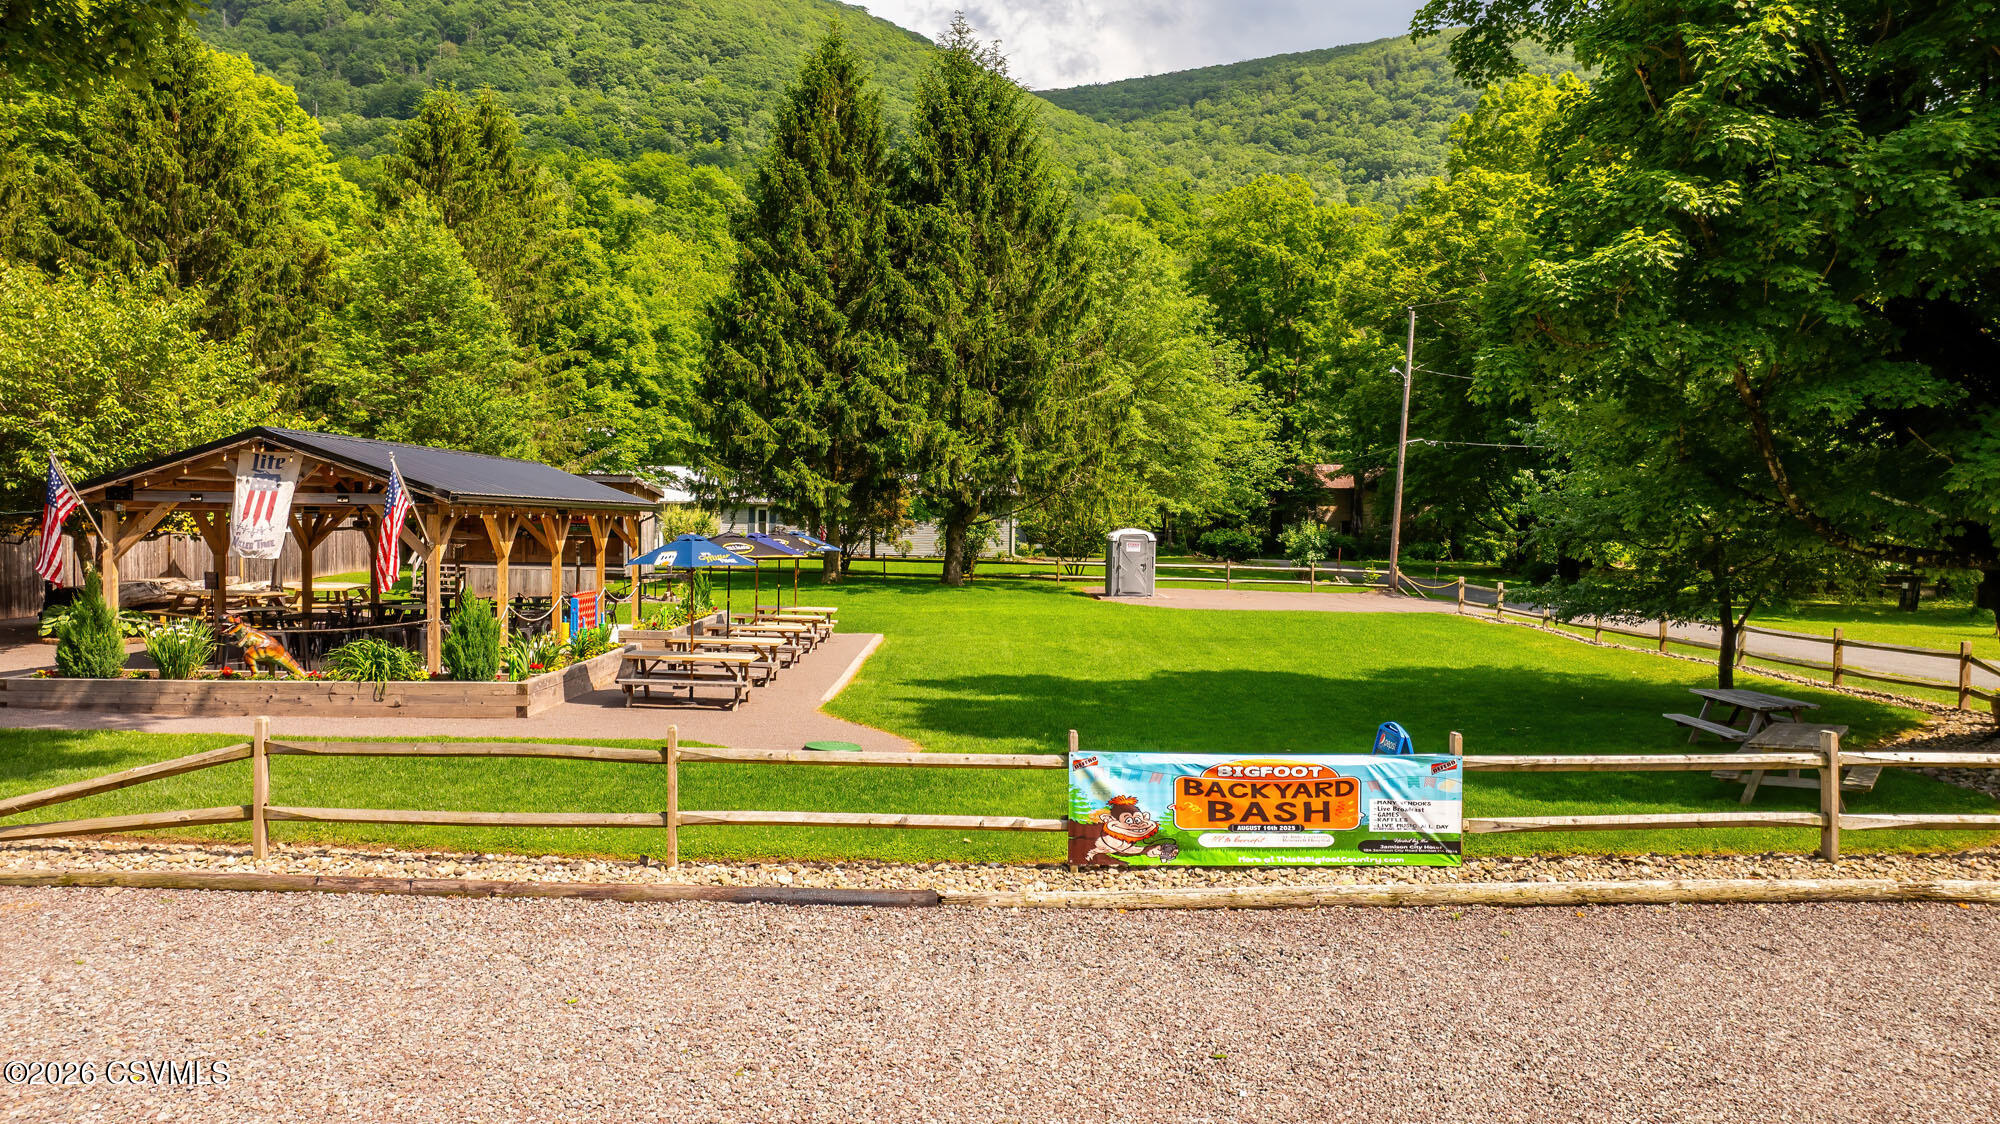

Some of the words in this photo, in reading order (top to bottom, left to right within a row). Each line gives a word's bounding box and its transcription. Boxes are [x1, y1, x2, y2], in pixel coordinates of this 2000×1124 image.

[252, 453, 286, 472] Lite
[1217, 765, 1323, 778] BIGFOOT
[1183, 778, 1355, 799] BACKYARD
[1207, 800, 1331, 823] BASH
[1238, 856, 1262, 864] More
[1263, 856, 1275, 864] at
